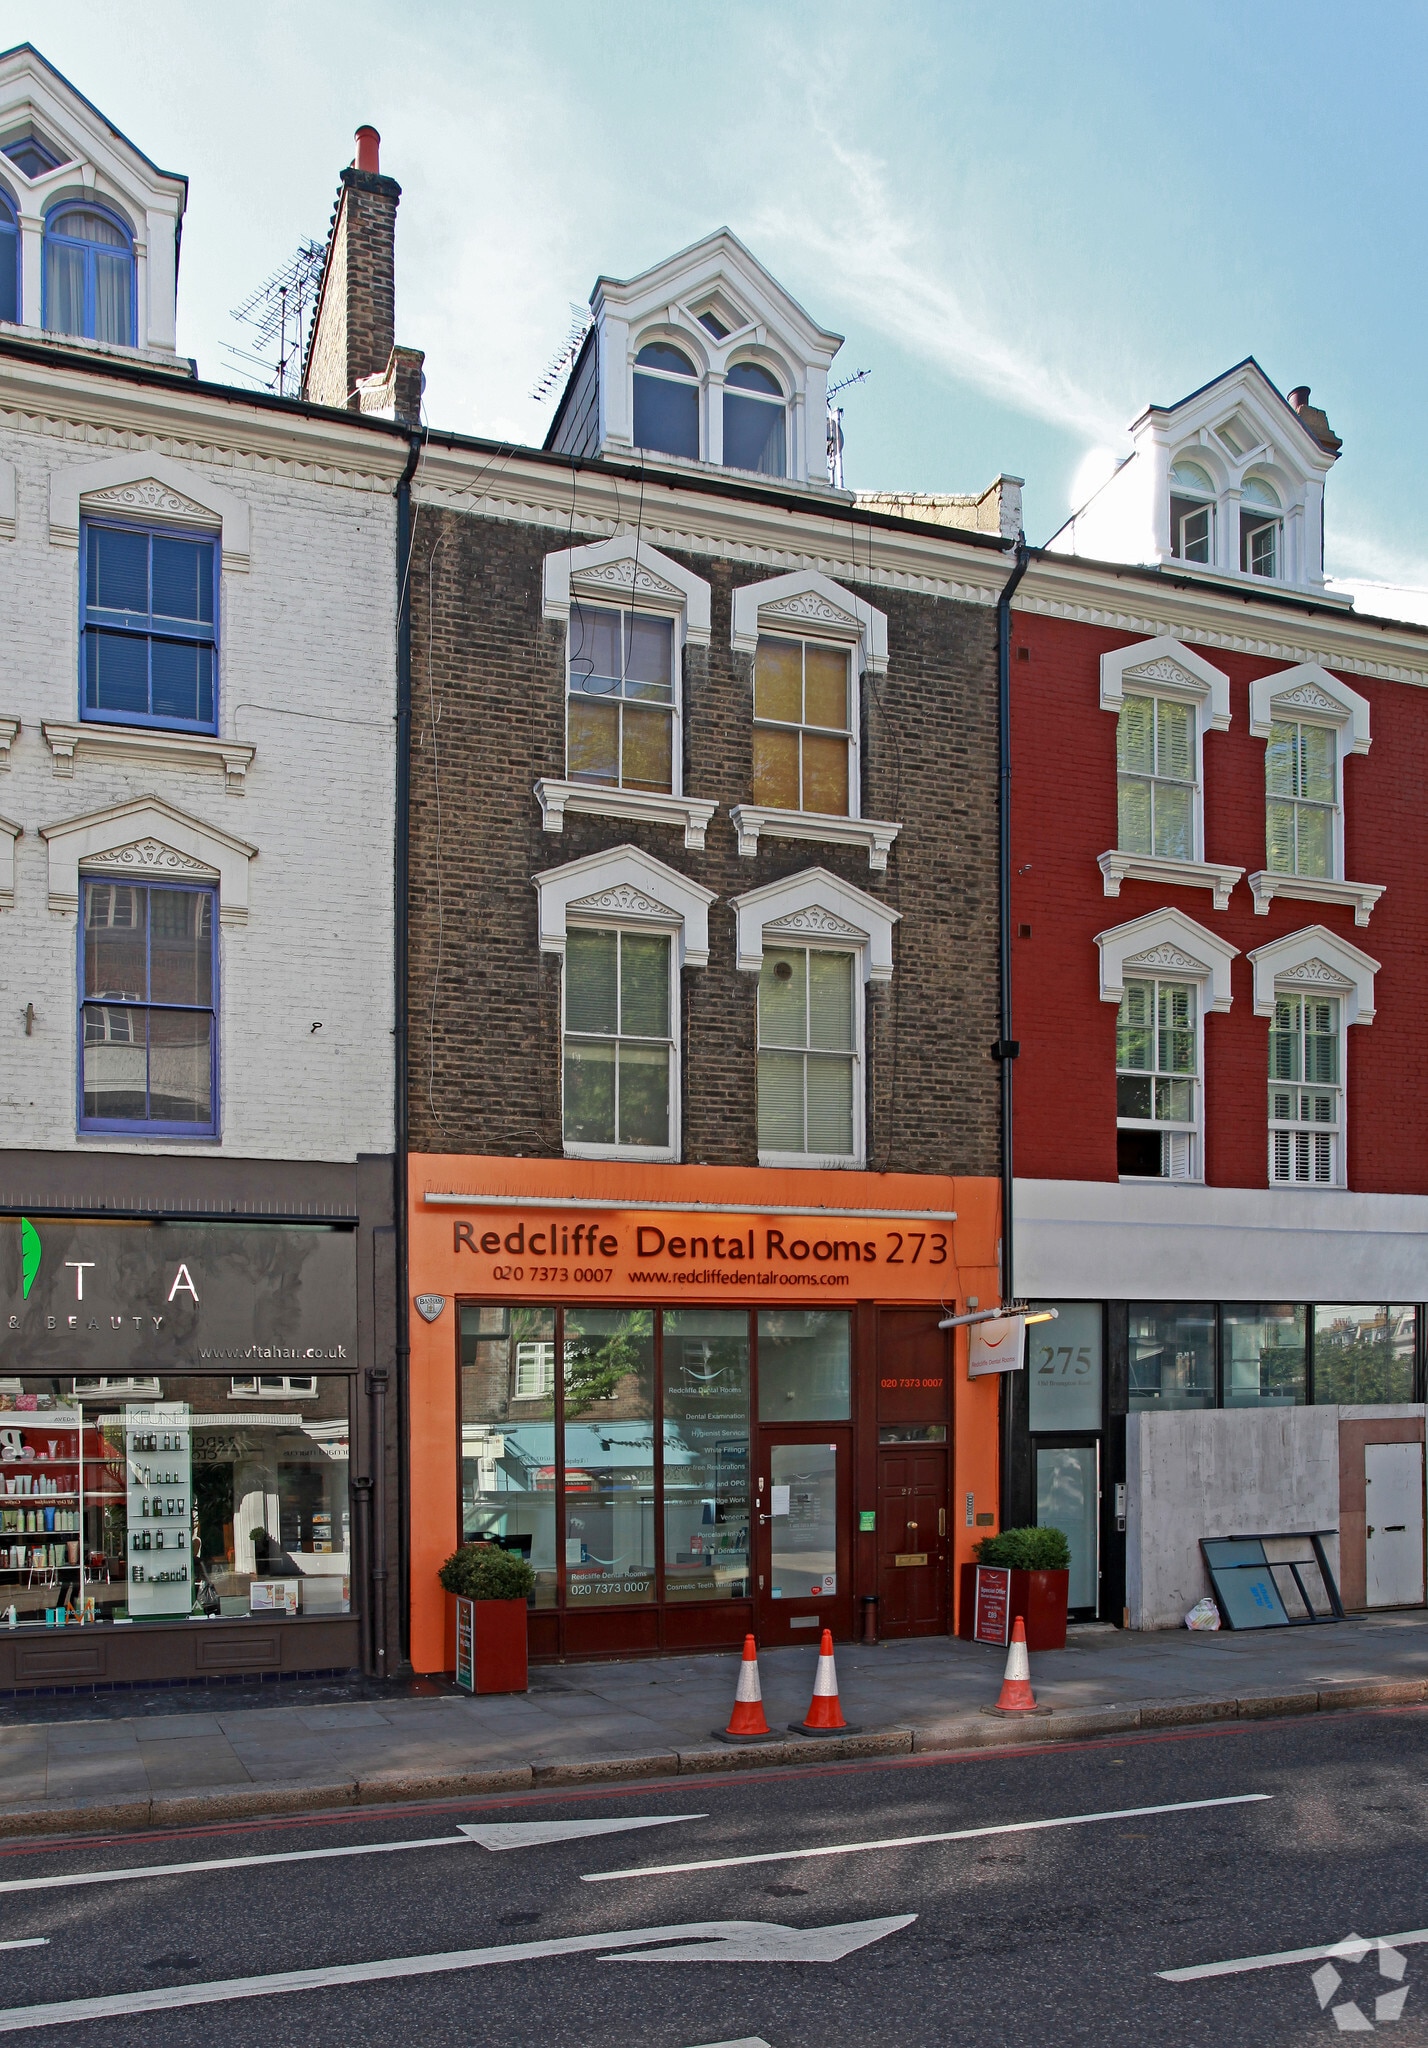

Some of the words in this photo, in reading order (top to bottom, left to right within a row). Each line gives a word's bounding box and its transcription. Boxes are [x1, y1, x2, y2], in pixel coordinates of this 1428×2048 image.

[453, 1220, 618, 1255] Redcliffe
[636, 1226, 754, 1260] Dental
[766, 1229, 877, 1262] Rooms
[886, 1232, 948, 1264] 273
[493, 1265, 524, 1281] 020
[529, 1267, 569, 1282] 7373
[573, 1267, 613, 1283] 0007
[628, 1268, 849, 1286] www.redcliffedentalrooms.com
[47, 1316, 163, 1330] BEAUTY
[200, 1345, 346, 1359] www.vitahair.co.uk
[1038, 1346, 1092, 1375] 275
[880, 1379, 898, 1388] 020
[899, 1379, 921, 1387] 7373
[922, 1378, 943, 1387] 0007
[707, 1412, 746, 1420] Examination
[691, 1430, 721, 1438] Hygienist
[723, 1446, 746, 1454] Fillings
[571, 1584, 592, 1595] 020
[595, 1583, 621, 1594] 7373
[624, 1581, 650, 1592] 0007
